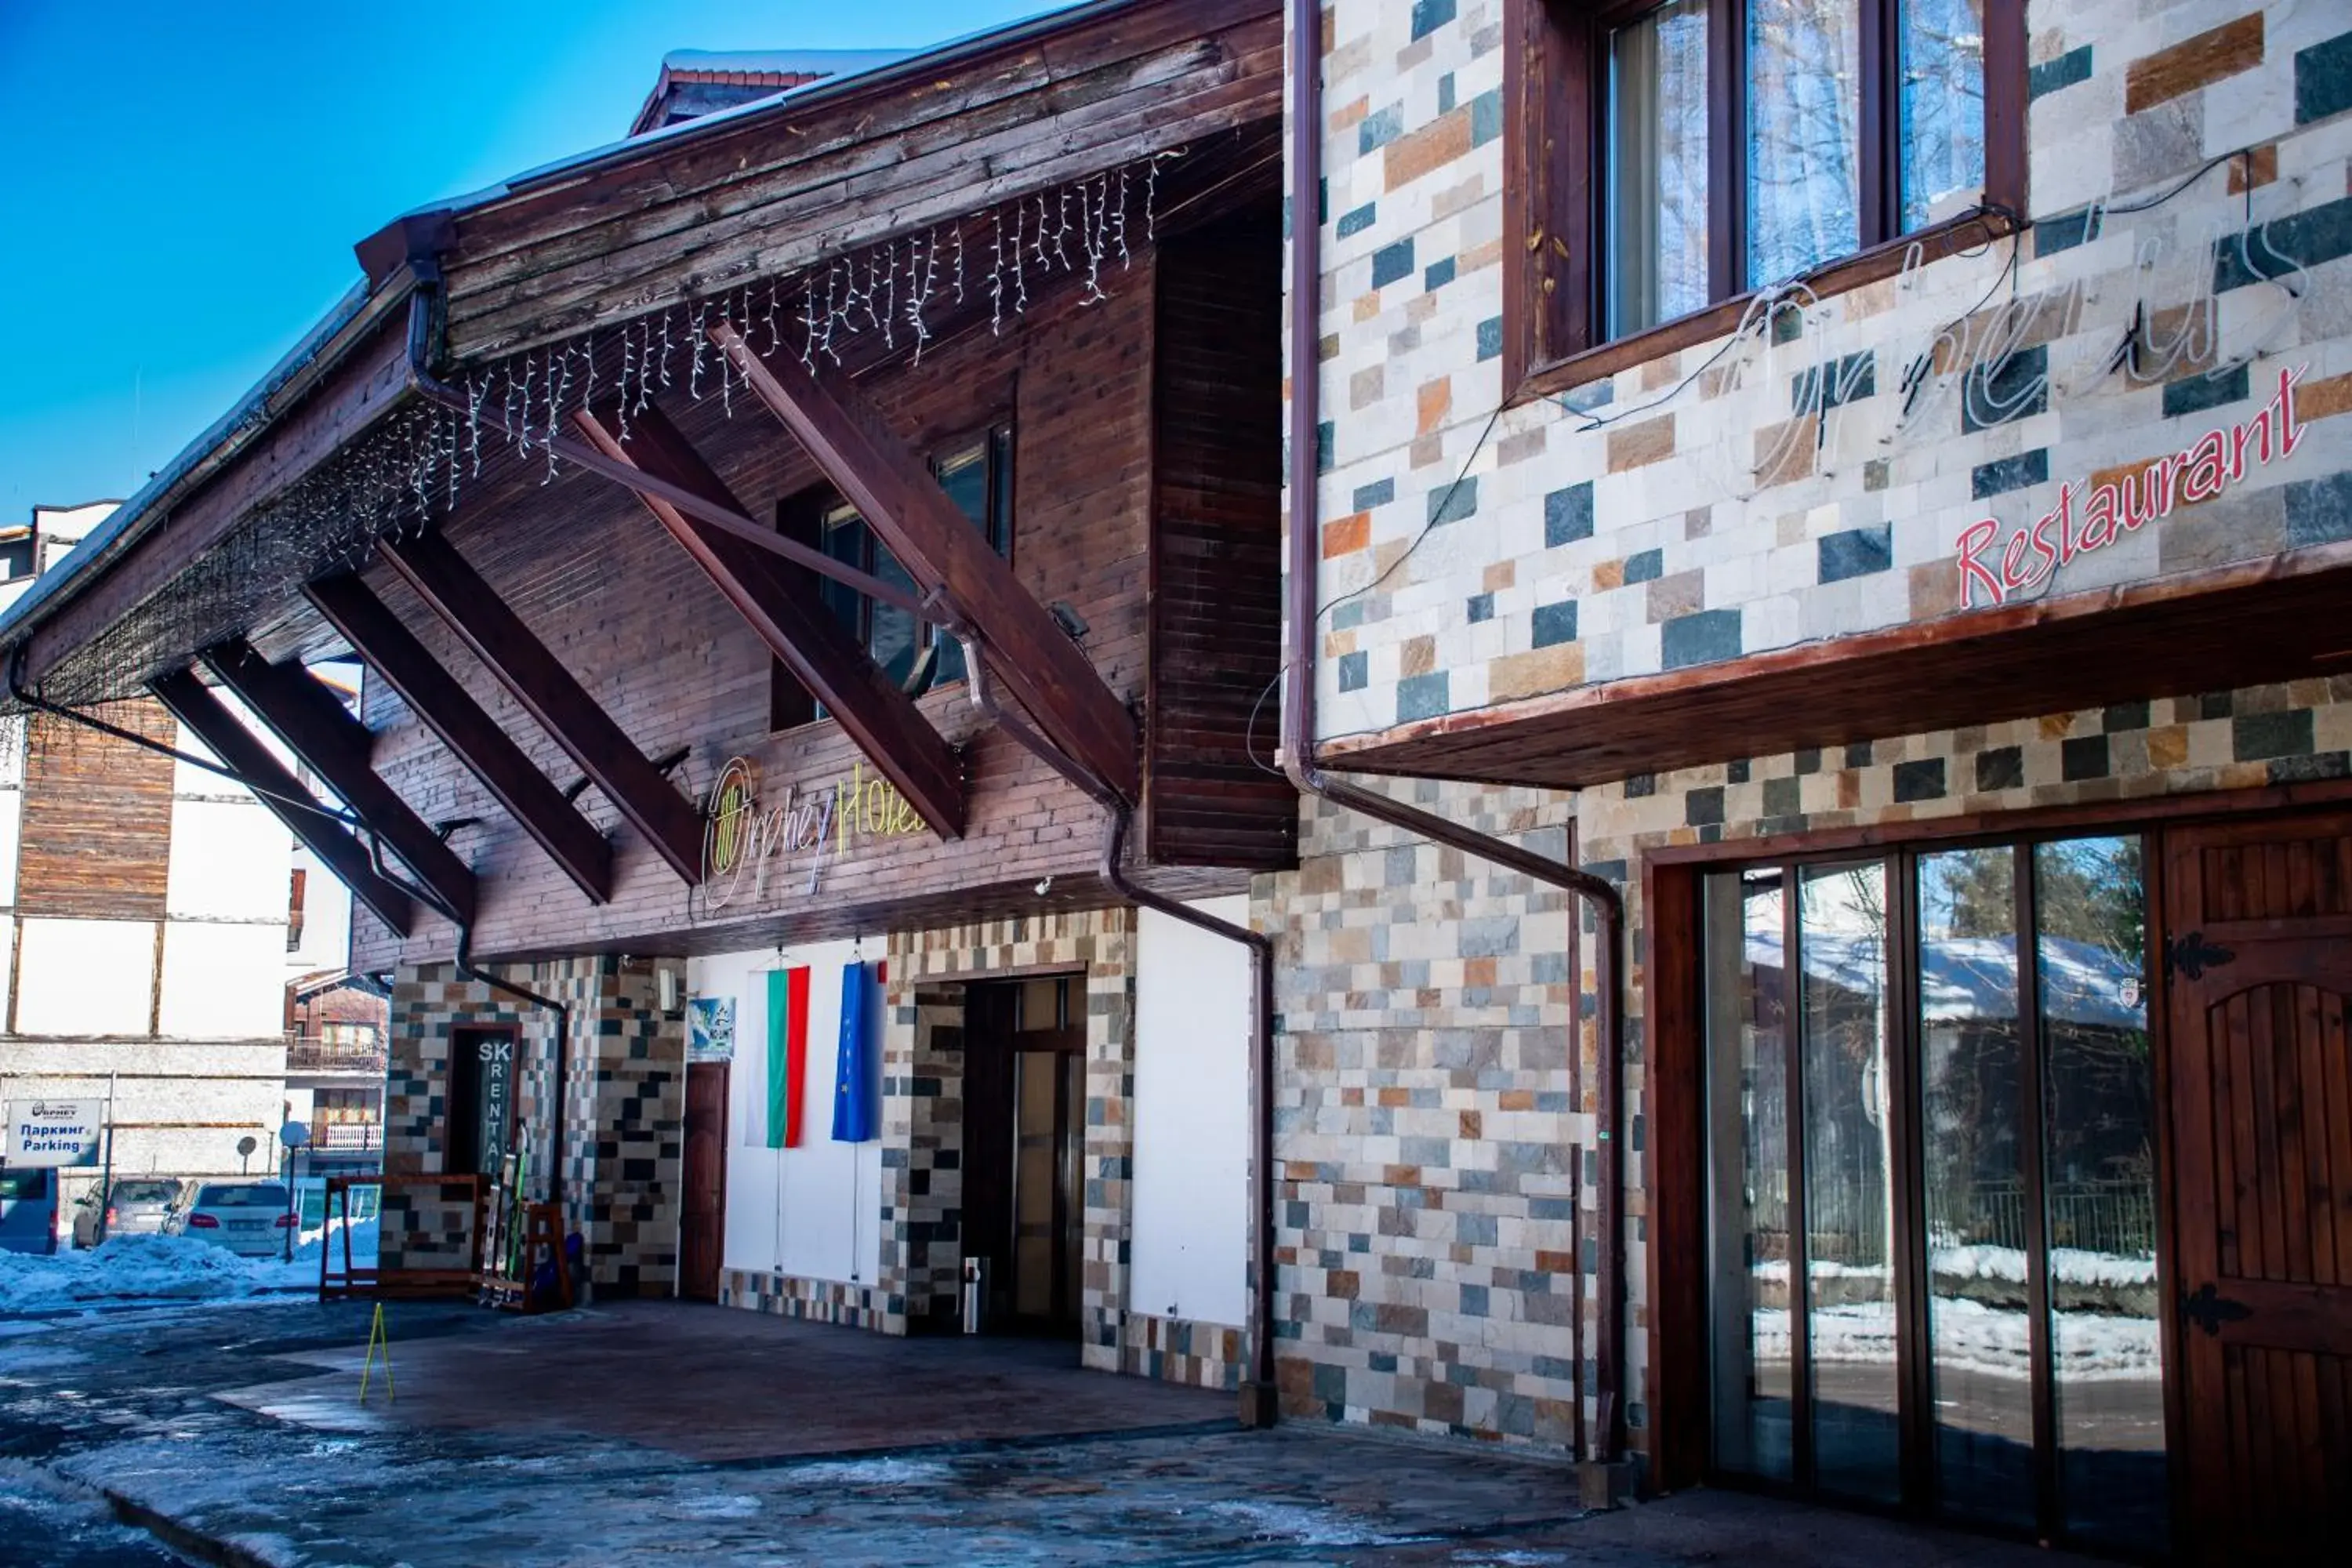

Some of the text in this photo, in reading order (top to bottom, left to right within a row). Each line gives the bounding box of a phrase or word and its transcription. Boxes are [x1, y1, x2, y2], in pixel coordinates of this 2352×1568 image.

[1955, 361, 2310, 611] Restaurant
[702, 755, 927, 908] Orphey Hote
[21, 1123, 85, 1137] Паркинг
[24, 1139, 79, 1152] Parking
